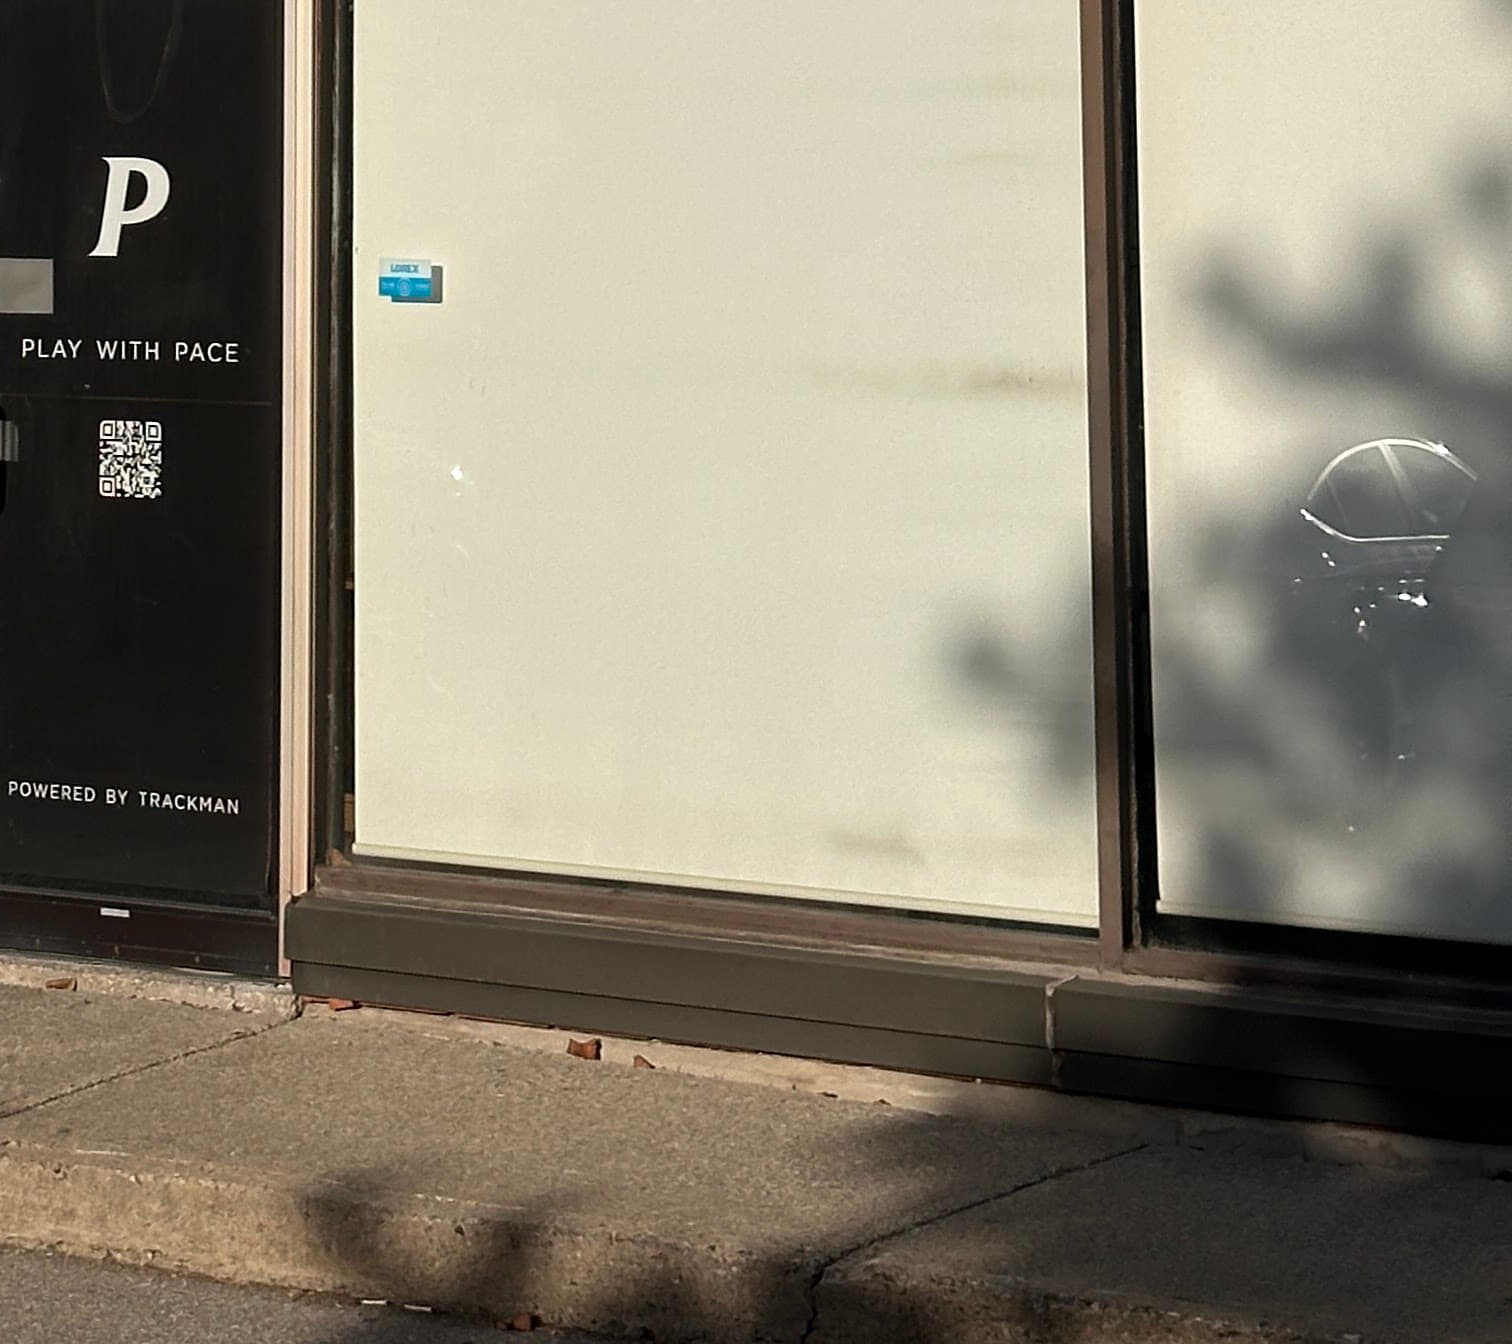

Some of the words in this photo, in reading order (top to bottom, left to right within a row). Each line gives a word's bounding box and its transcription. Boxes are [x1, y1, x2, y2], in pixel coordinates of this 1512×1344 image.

[89, 157, 170, 256] P
[21, 339, 83, 358] PLAY
[95, 340, 160, 360] WITH
[175, 342, 239, 362] PACE
[8, 781, 96, 801] POWERED
[105, 789, 129, 804] BY
[138, 792, 239, 814] TRACKMAN
